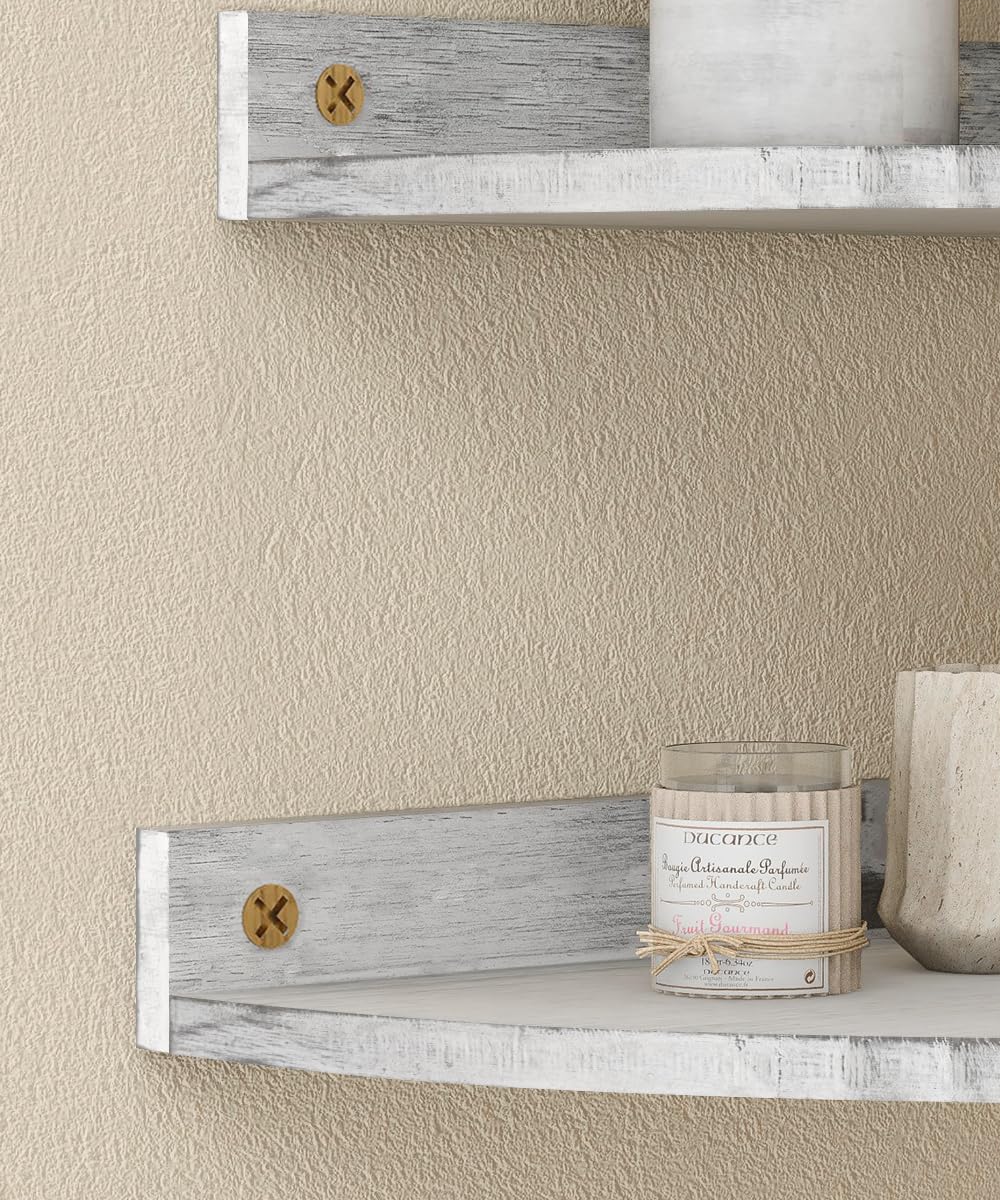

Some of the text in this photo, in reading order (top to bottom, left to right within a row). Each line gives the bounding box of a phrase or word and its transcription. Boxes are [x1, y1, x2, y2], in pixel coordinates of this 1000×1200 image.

[690, 856, 758, 875] Artisanale
[759, 858, 809, 879] Parfumée
[706, 875, 766, 894] Handcraft
[767, 877, 801, 891] Candle
[672, 912, 790, 936] Fruit Gourmand
